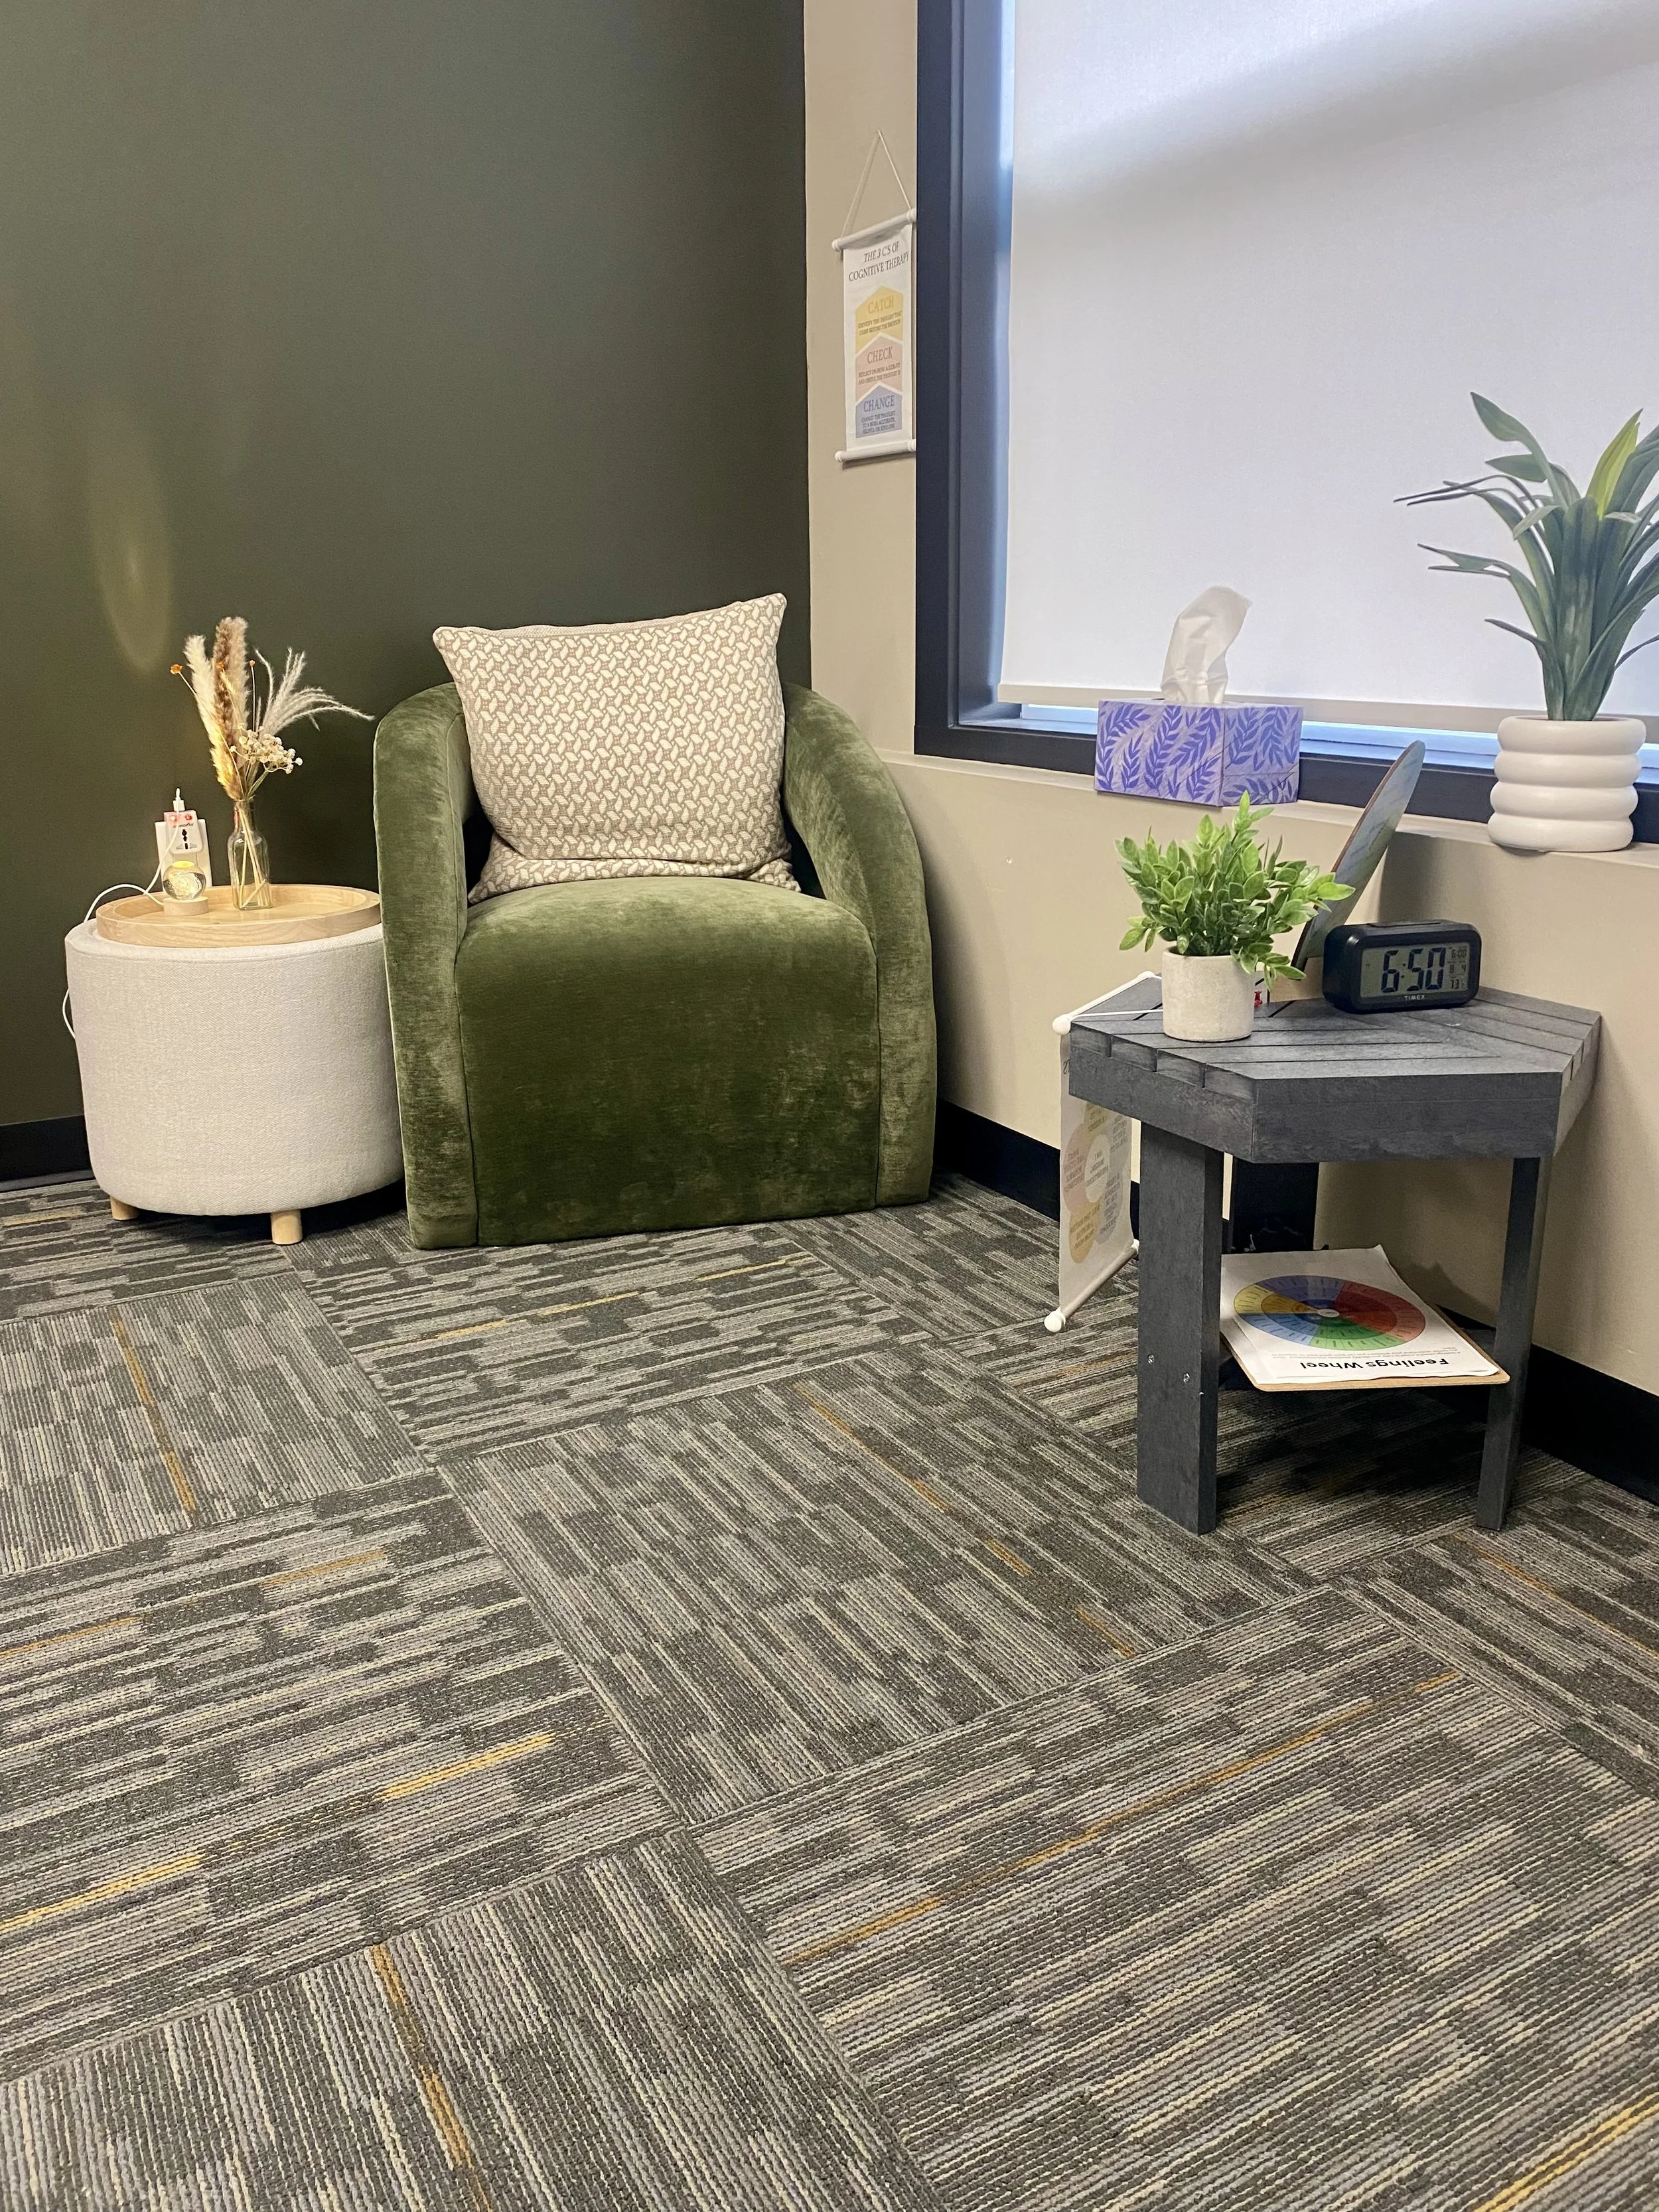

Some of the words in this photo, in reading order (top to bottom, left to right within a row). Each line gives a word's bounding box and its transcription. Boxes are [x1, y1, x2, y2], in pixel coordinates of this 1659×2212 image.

[864, 250, 877, 263] THE
[877, 249, 881, 259] 3
[892, 241, 899, 252] OF
[849, 262, 885, 281] COGNITIVE
[885, 252, 909, 271] THERAPY
[868, 295, 895, 314] CATCH
[867, 346, 893, 364] CHECK
[863, 395, 895, 412] CHANGE
[1381, 947, 1446, 993] 6:50
[1366, 1358, 1449, 1367] Feelings
